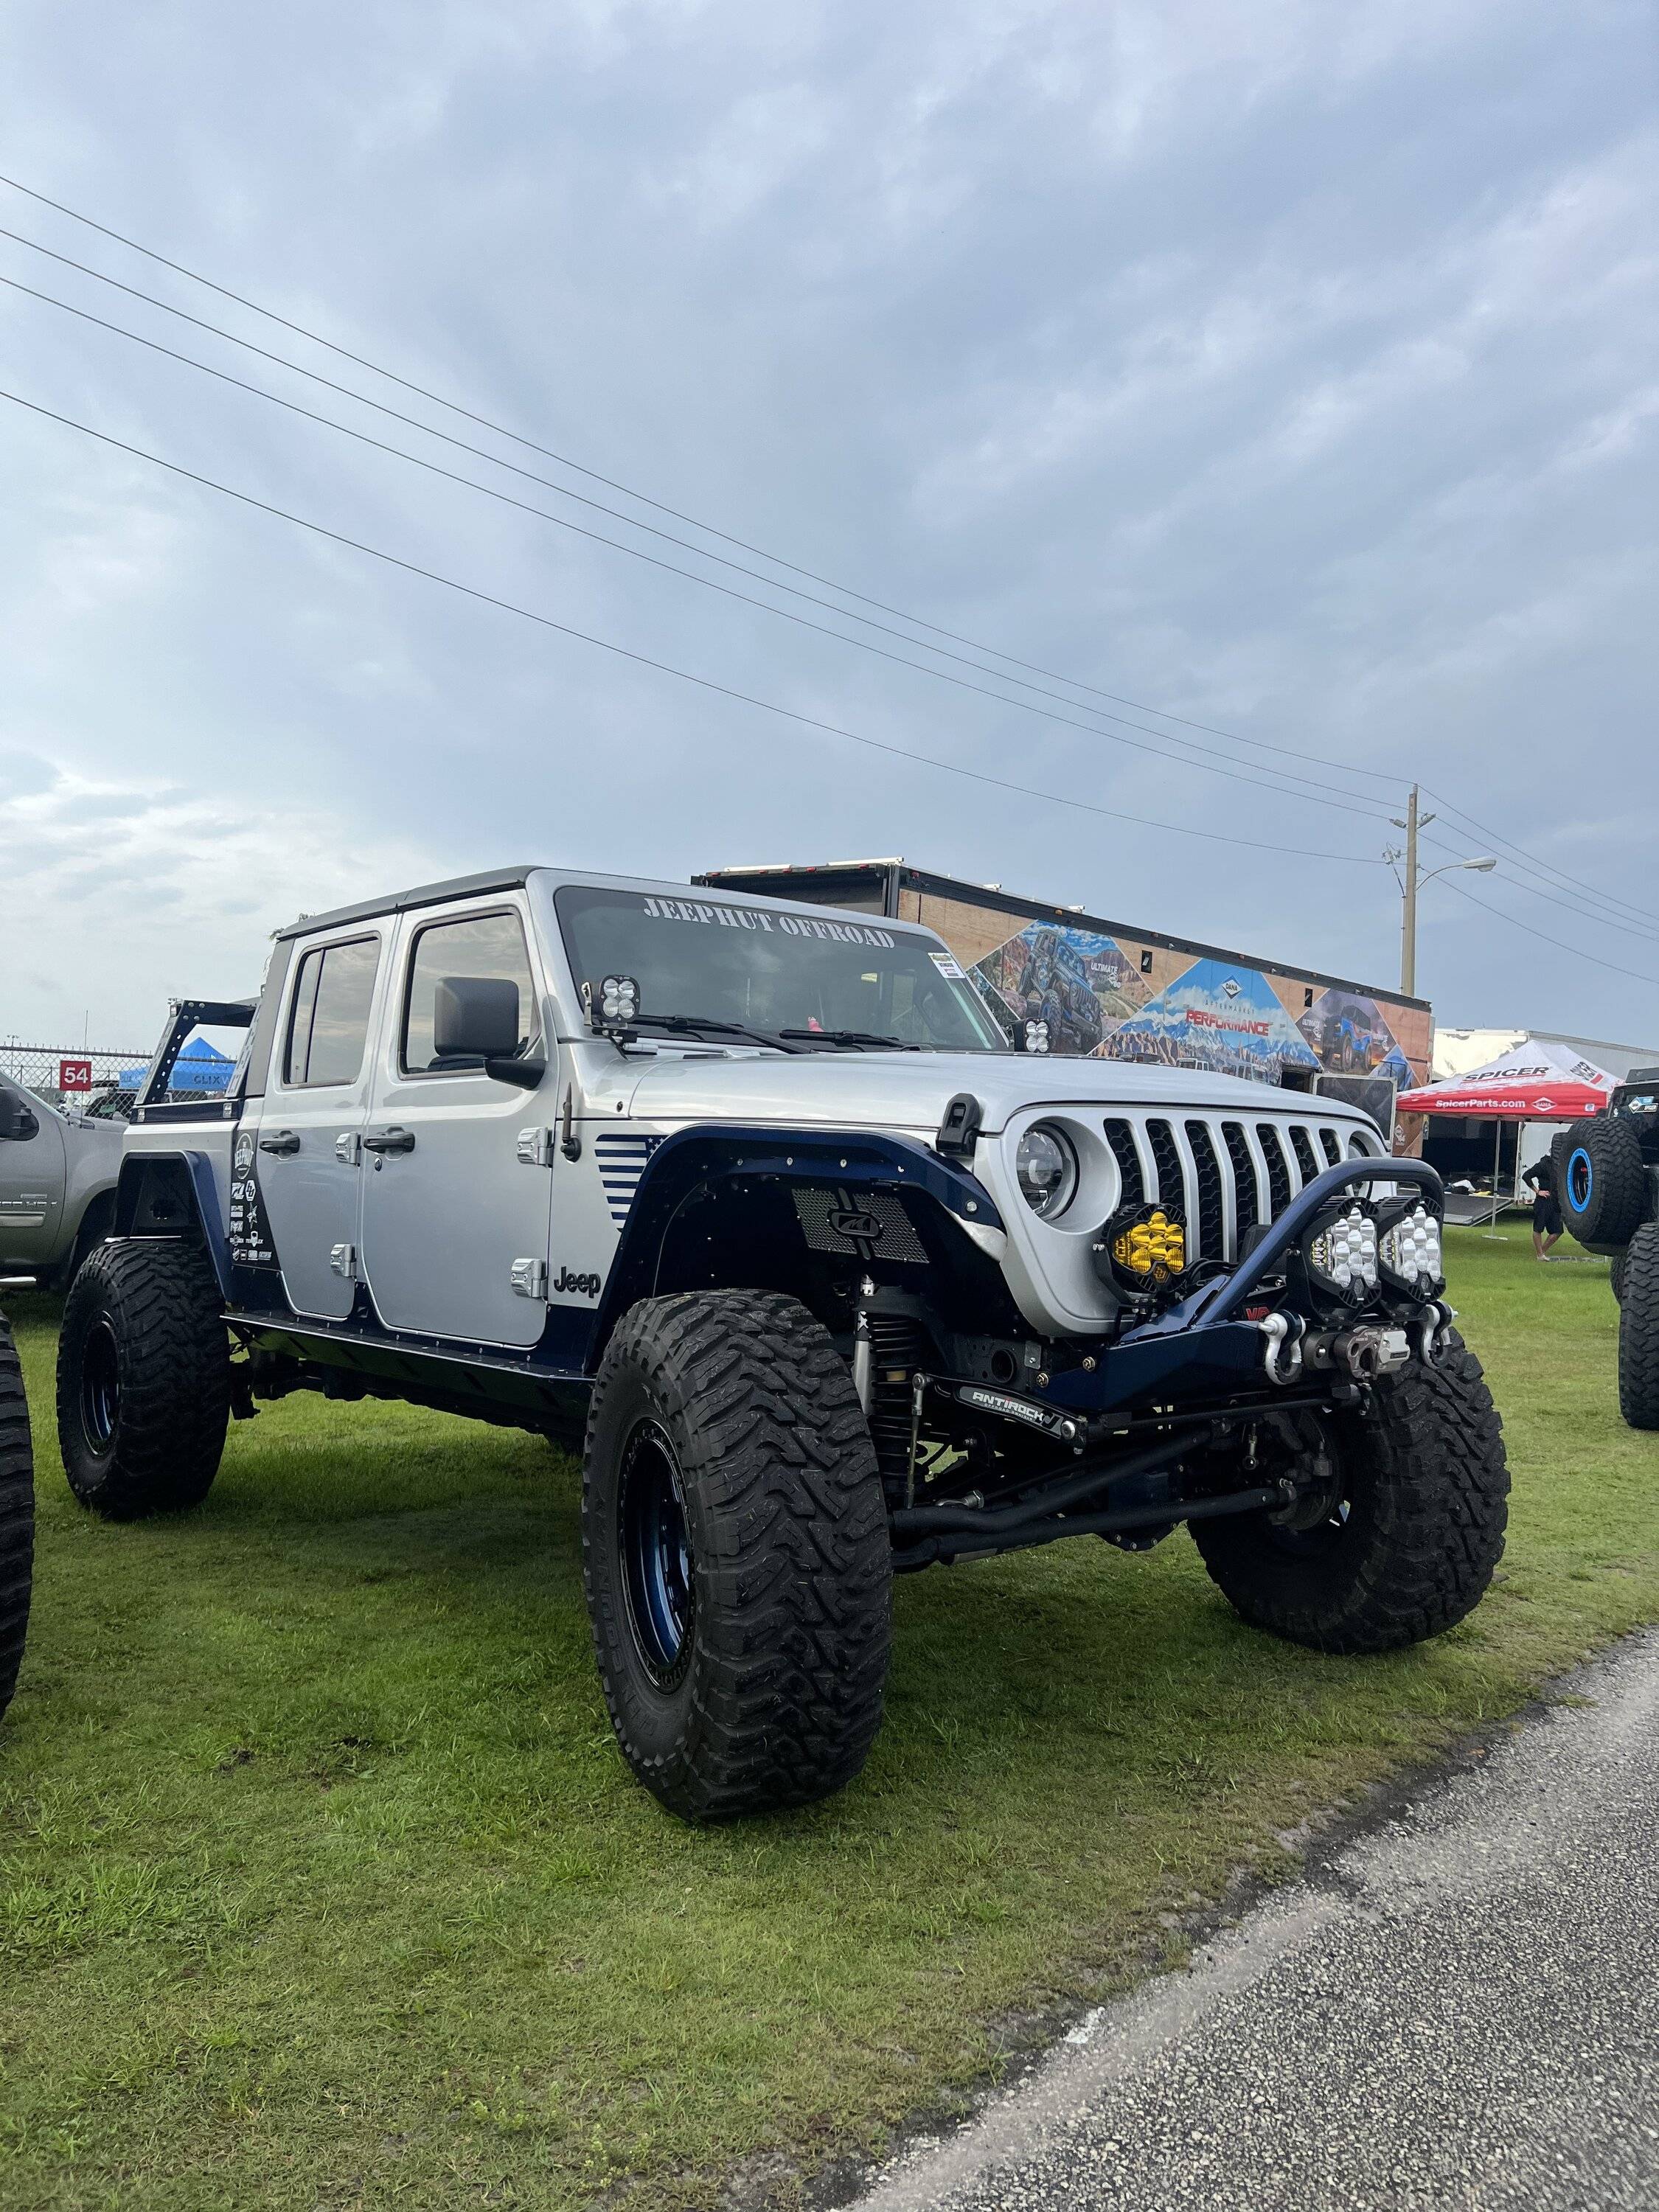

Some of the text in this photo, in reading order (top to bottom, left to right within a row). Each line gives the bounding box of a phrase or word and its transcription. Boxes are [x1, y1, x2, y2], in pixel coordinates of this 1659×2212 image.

[644, 897, 894, 948] JEEPHUT OFFROAD
[1091, 962, 1118, 973] ULTIMATE
[1225, 982, 1238, 991] DANA
[1205, 999, 1255, 1015] AFTERMARKET
[1186, 1009, 1270, 1037] PERFORMANCE
[64, 1066, 88, 1084] 54
[1463, 1067, 1549, 1081] SPICER
[1436, 1099, 1526, 1108] SpicerParts.com
[554, 1266, 601, 1298] Jeep
[973, 1391, 1044, 1422] ANTIROCK
